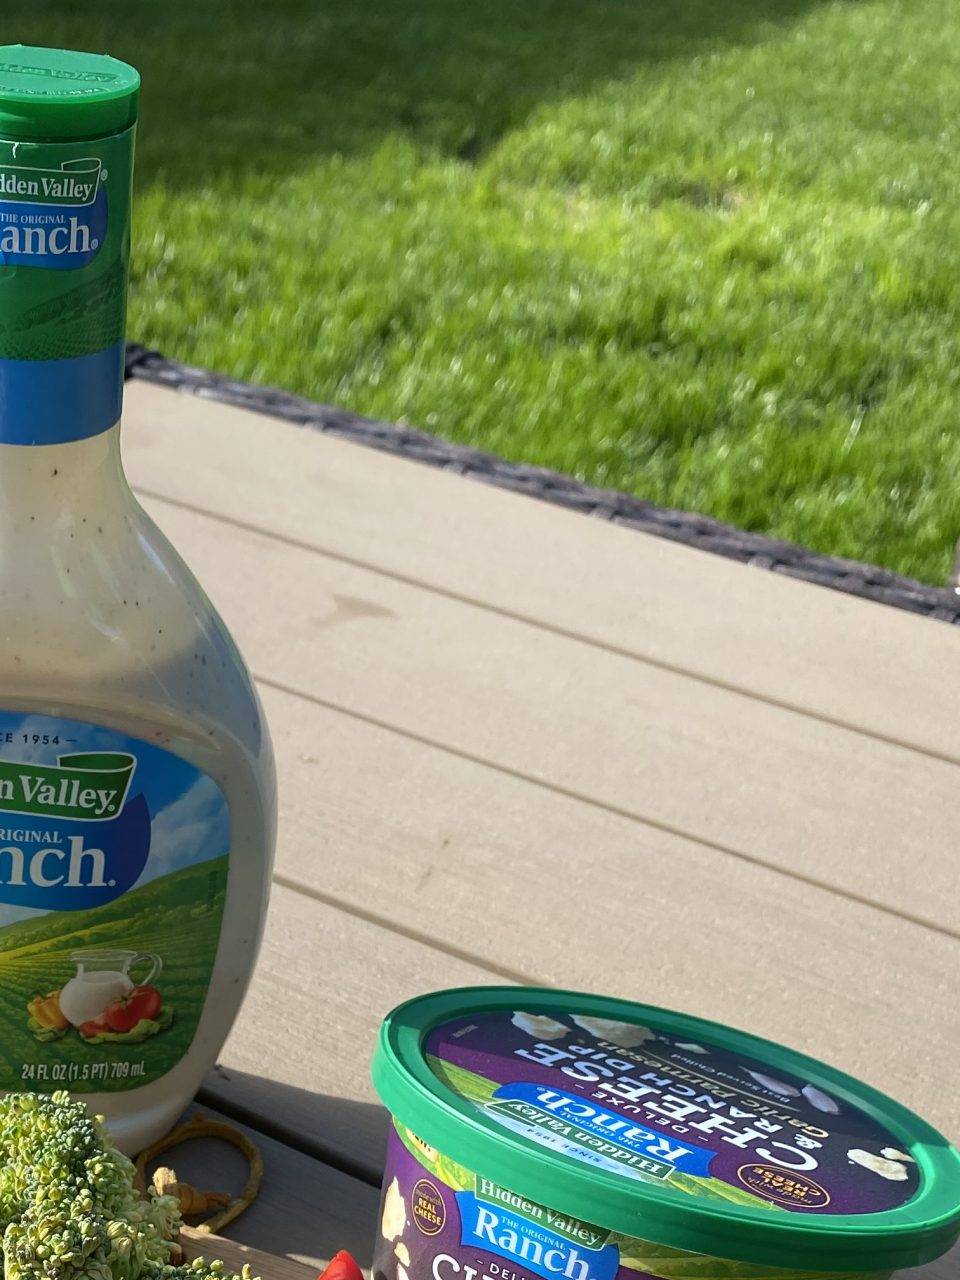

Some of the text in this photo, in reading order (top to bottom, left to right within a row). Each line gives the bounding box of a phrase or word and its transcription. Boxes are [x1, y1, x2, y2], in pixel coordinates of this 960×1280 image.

[40, 178, 93, 201] Valley
[0, 212, 66, 224] THE ORIGINAL
[22, 734, 60, 745] 1954
[18, 775, 117, 814] Valley
[21, 1061, 146, 1081] 24 FL OZ (1.5 PT) 709 mL
[670, 1053, 716, 1074] Chilled
[568, 1045, 823, 1149] & RANCH DIP
[597, 1041, 829, 1138] Garlic Parmesan
[717, 1072, 764, 1096] Served
[513, 1043, 818, 1171] CHEESE
[591, 1090, 690, 1134] DELUXE
[508, 1103, 664, 1173] Hidden Valley
[536, 1090, 694, 1163] Ranch
[560, 1110, 640, 1148] THE ORIGINAL
[562, 1143, 601, 1162] SINCE
[753, 1166, 821, 1196] CHEESE
[762, 1176, 806, 1197] REAL
[414, 1205, 442, 1226] CHEESE
[418, 1197, 437, 1214] REAL
[481, 1176, 602, 1245] Hidden Valley
[501, 1215, 566, 1250] THE ORIGINAL
